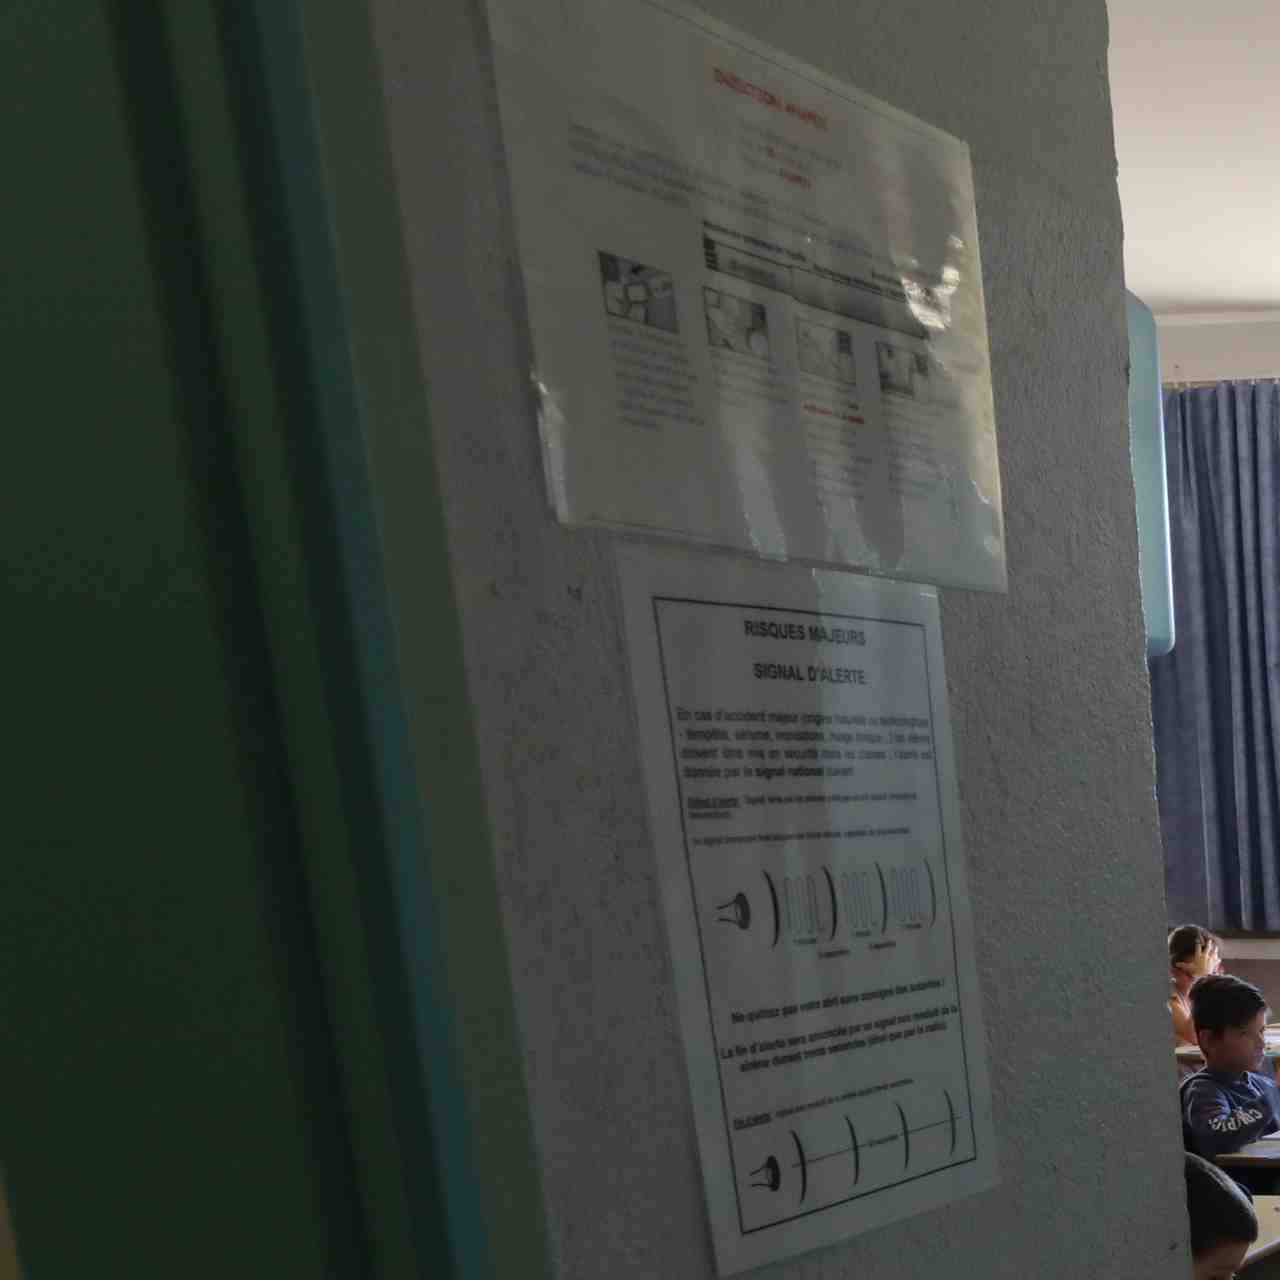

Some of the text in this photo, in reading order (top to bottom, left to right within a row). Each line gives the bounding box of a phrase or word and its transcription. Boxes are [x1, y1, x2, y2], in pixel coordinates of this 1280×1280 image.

[743, 619, 867, 647] RISQUES MAJEURS
[752, 662, 866, 685] SIGNAL D'ALERTE
